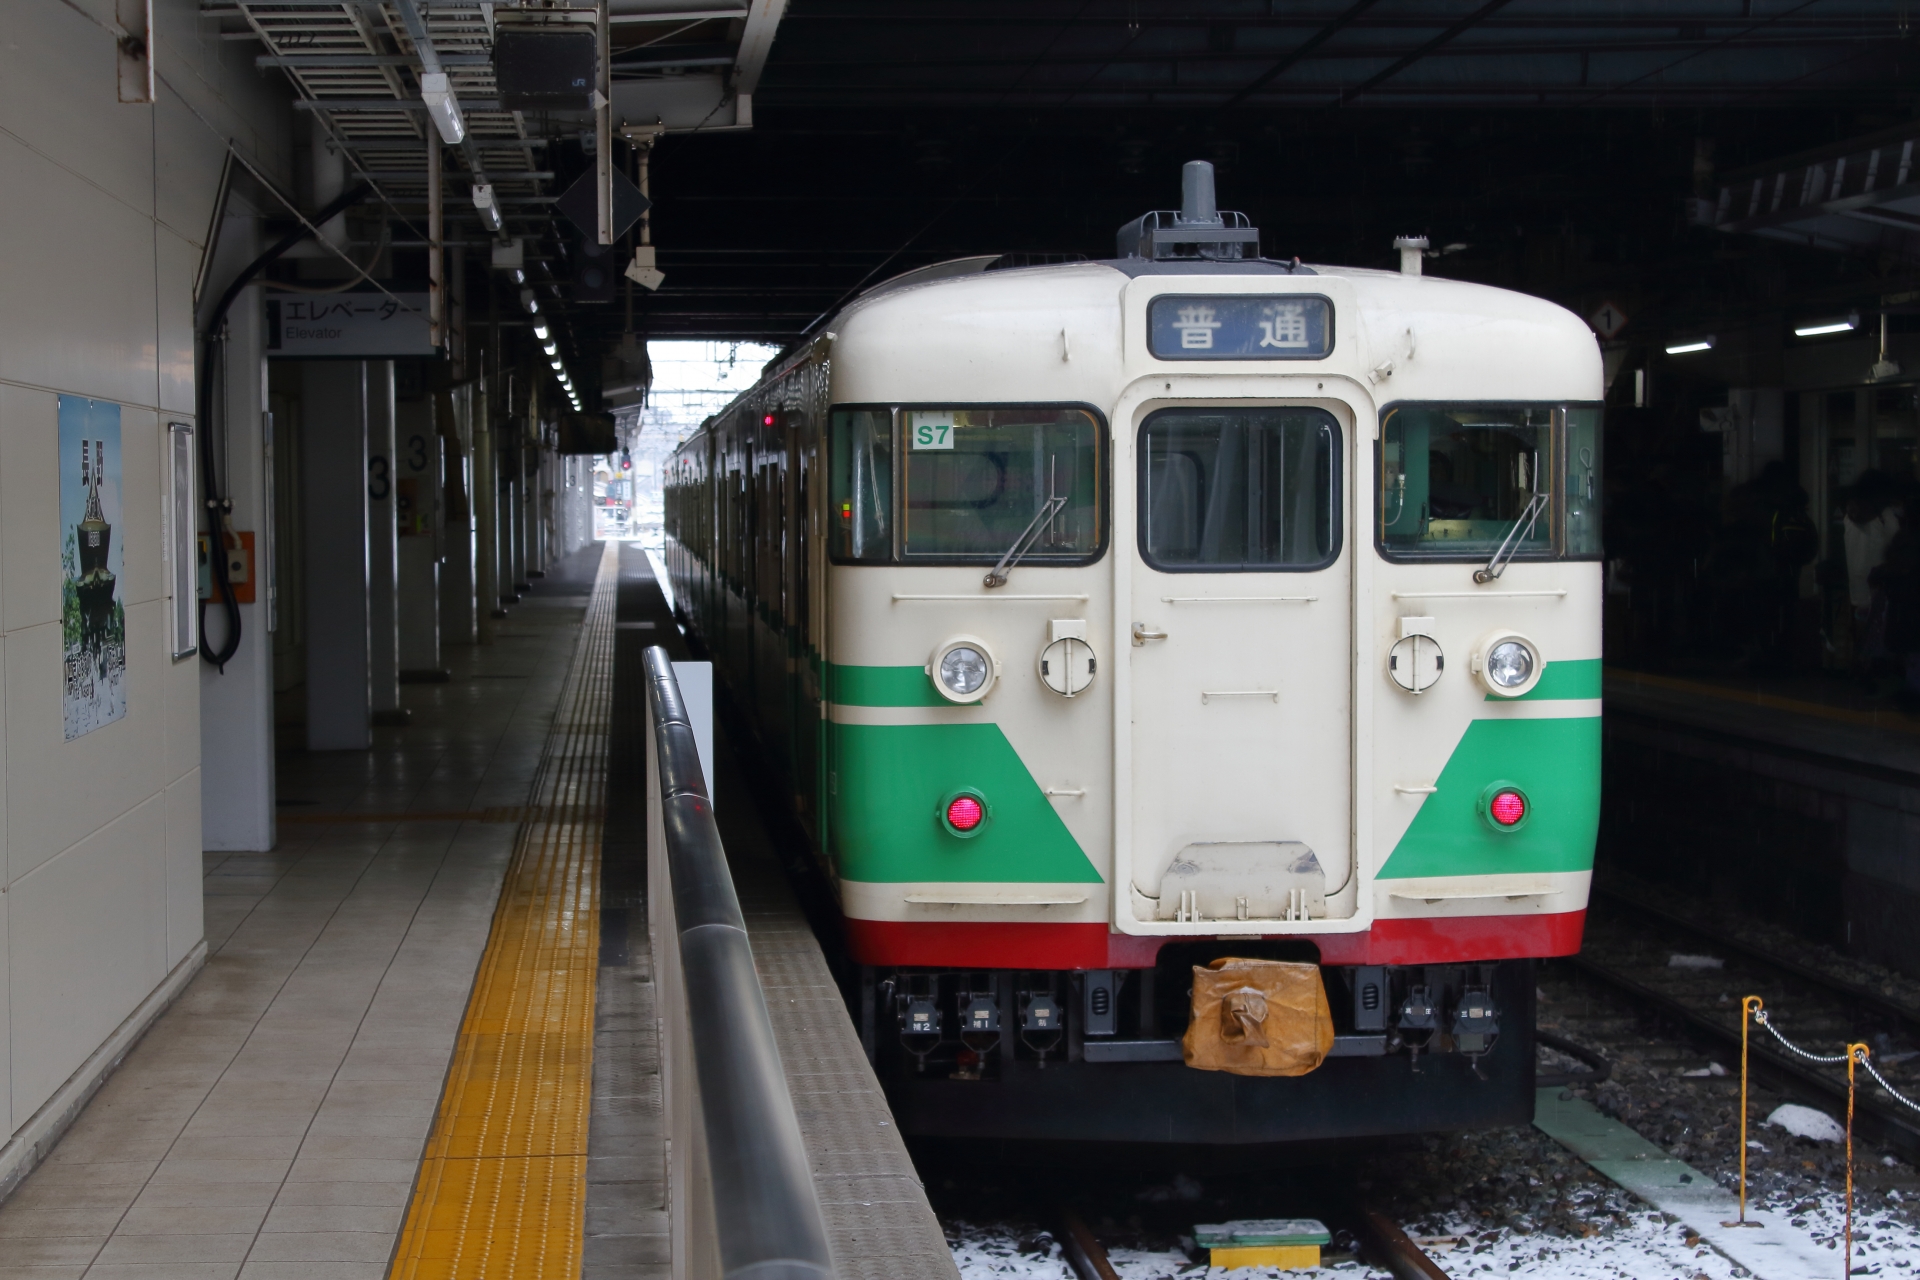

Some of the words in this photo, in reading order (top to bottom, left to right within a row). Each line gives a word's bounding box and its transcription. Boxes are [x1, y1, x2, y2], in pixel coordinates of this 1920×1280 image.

[571, 78, 586, 87] JR
[286, 300, 422, 321] エレベーター
[1602, 309, 1611, 330] 1
[286, 327, 343, 339] Elevator
[1171, 305, 1310, 349] 普通
[917, 425, 949, 445] S7
[409, 434, 427, 471] 3
[368, 455, 389, 500] 3
